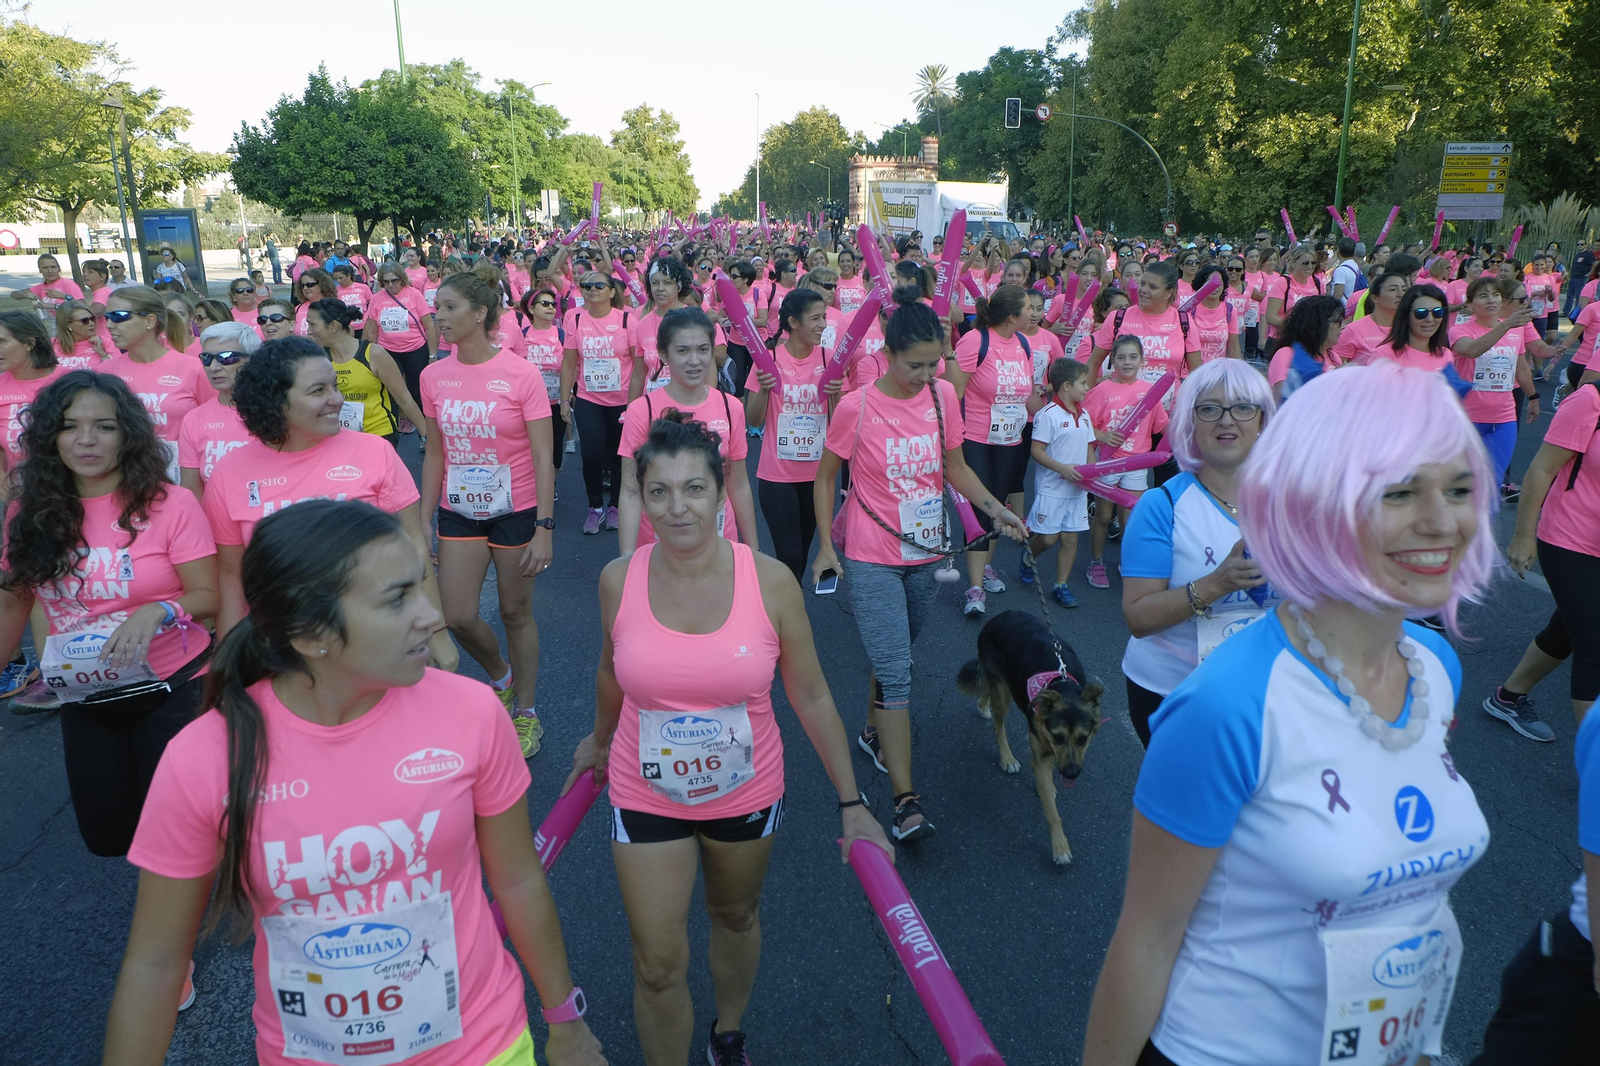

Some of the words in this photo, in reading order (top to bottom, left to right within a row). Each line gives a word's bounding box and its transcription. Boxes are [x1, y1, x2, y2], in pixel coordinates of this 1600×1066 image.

[883, 201, 916, 218] Demetrio
[934, 260, 951, 297] Ladival
[582, 336, 614, 349] HOY
[527, 345, 556, 357] HOY
[582, 348, 614, 358] GANAN
[437, 380, 462, 388] OYSHO
[997, 375, 1031, 386] GANAN
[1488, 372, 1507, 380] 016
[996, 385, 1017, 396] LAS
[441, 398, 498, 425] HOY
[782, 402, 823, 414] GANAN
[441, 422, 498, 439] GANAN
[444, 436, 472, 452] LAS
[793, 436, 814, 446] 016
[885, 431, 939, 464] HOY
[447, 450, 499, 465] CHICAS
[885, 458, 941, 480] GANAN
[888, 478, 918, 493] LAS
[466, 492, 494, 503] 016
[921, 523, 944, 540] 016
[64, 645, 102, 656] ASTURIA
[75, 668, 120, 684] 016
[665, 725, 718, 739] ASTURIANA
[401, 759, 460, 779] ASTURIANA
[673, 755, 722, 776] 016
[687, 774, 713, 787] 4735
[263, 809, 442, 901] HOY
[886, 903, 940, 969] Ladival
[311, 936, 404, 960] ASTURIANA
[373, 959, 411, 975] Carrera
[324, 984, 404, 1019] 016
[344, 1020, 386, 1037] 4736
[1378, 996, 1428, 1047] 016
[293, 1031, 335, 1053] OYSHO
[355, 1041, 392, 1053] Santander
[408, 1030, 442, 1050] ZURICH
